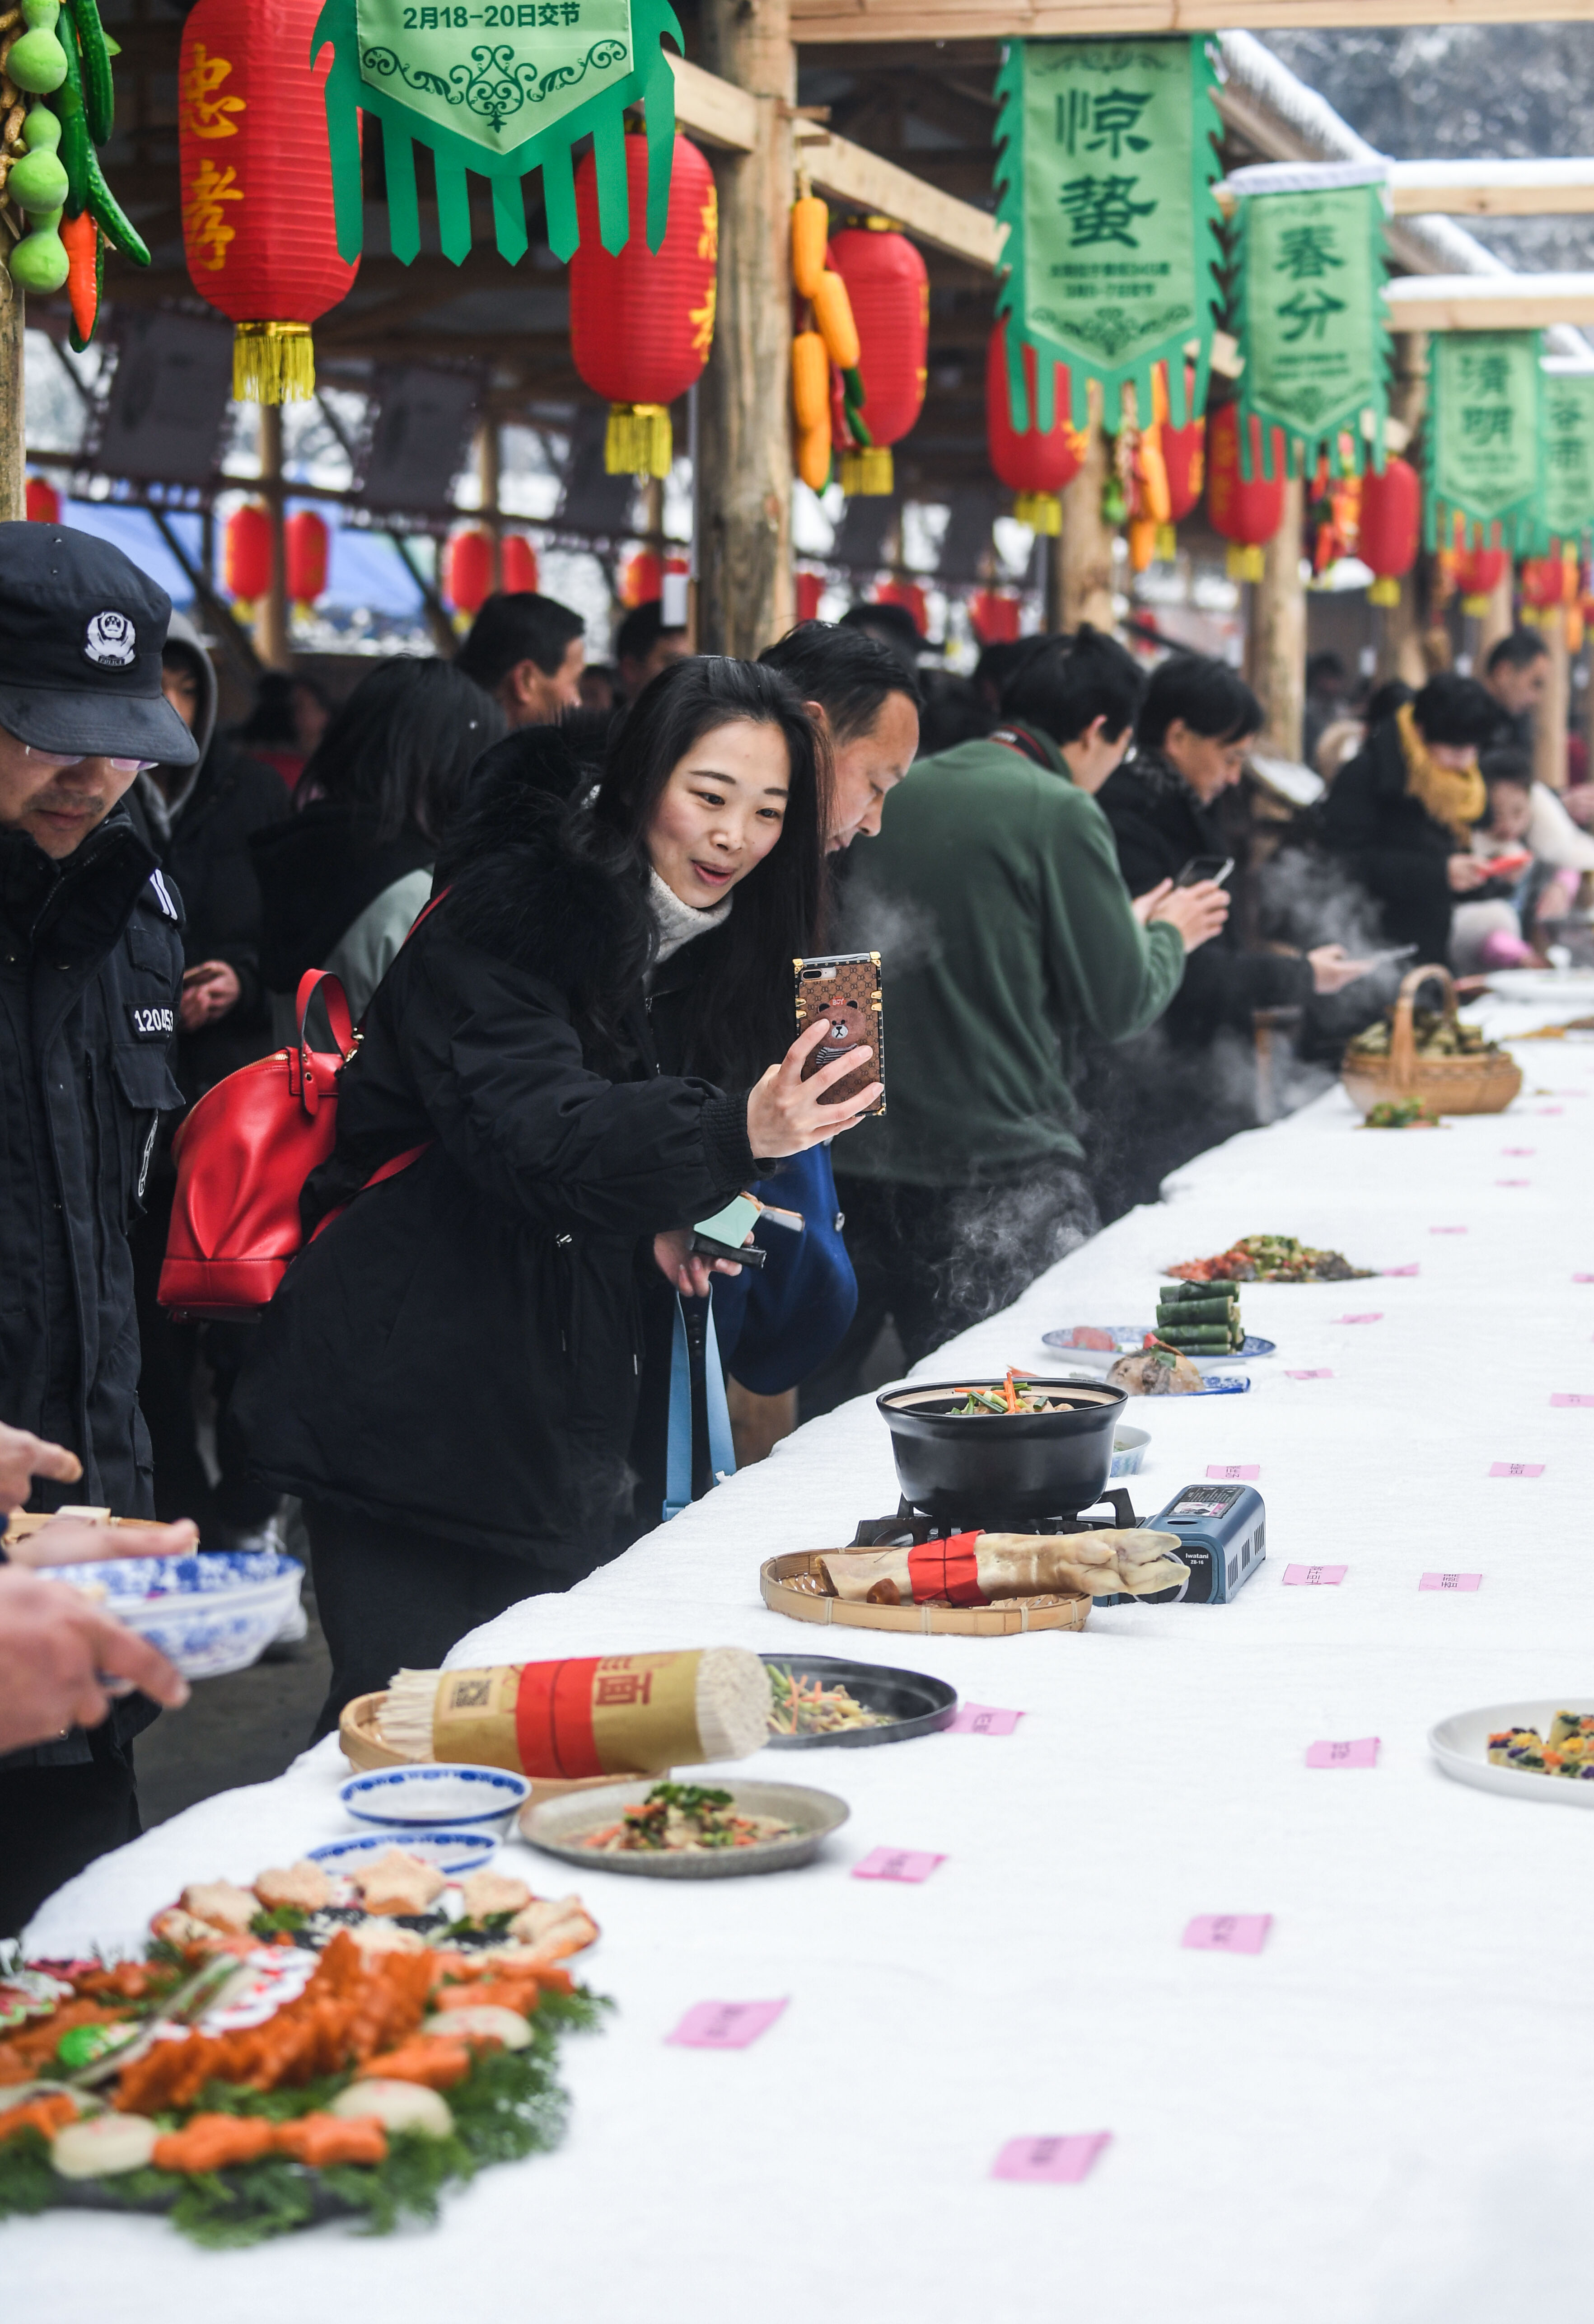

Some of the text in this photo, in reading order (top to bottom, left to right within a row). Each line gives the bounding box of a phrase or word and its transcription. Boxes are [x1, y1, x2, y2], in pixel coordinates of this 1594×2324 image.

[402, 2, 580, 30] 2月18-20日交节
[182, 42, 247, 271] 忠孝
[1055, 88, 1158, 248] 惊蛰
[1275, 225, 1345, 342] 春分
[1457, 355, 1513, 446] 清明
